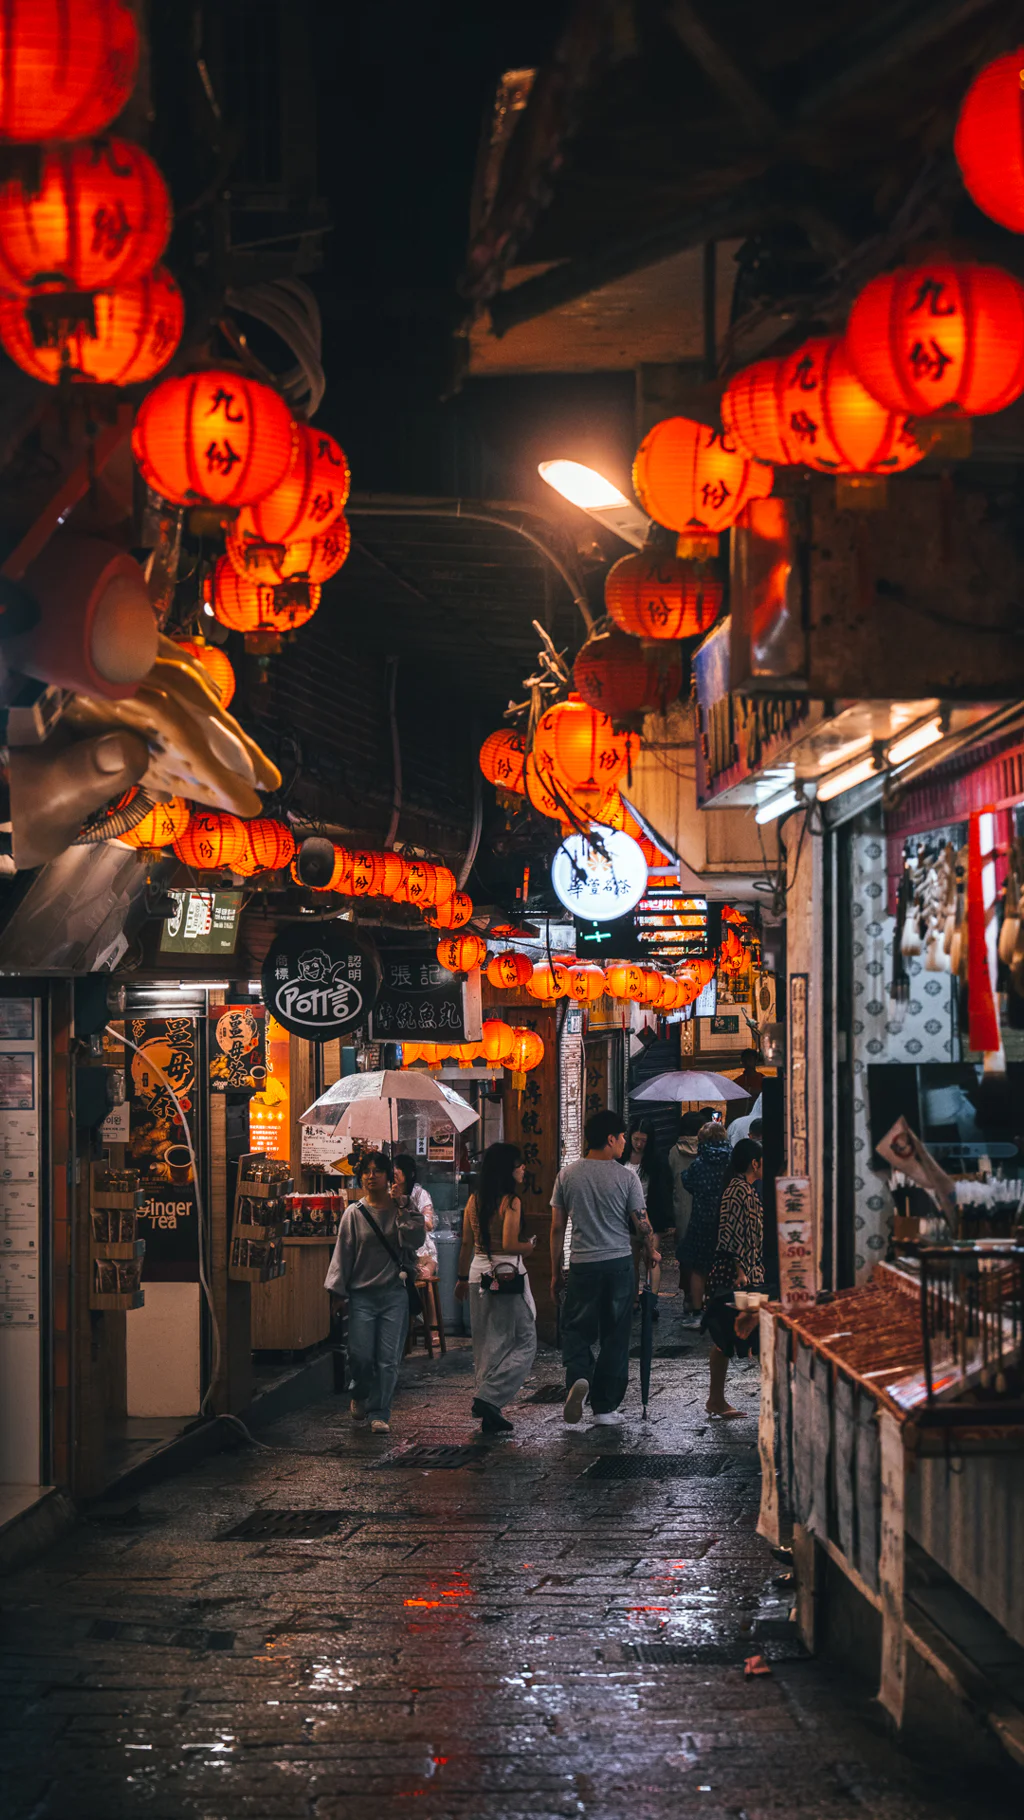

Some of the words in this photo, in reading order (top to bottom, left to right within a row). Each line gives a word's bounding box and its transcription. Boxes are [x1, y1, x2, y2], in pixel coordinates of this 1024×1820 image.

[909, 279, 956, 381] 九份
[789, 354, 817, 445] 九份
[205, 388, 243, 476] 九份
[308, 438, 342, 523] 九份
[702, 428, 736, 510] 九份
[644, 559, 673, 626] 九份
[198, 817, 214, 859] 九份
[355, 854, 372, 890] 九份
[410, 865, 423, 897] 九份
[454, 894, 467, 924] 九份
[274, 954, 290, 981] 商標
[348, 955, 362, 982] 認明
[390, 965, 441, 986] 張記
[503, 959, 517, 982] 九份
[575, 971, 585, 995] 九份
[629, 970, 638, 993] 九份
[377, 1001, 462, 1030] 傳統魚丸
[228, 1013, 248, 1087] 薑母茶
[147, 1018, 194, 1119] 薑母茶
[136, 1198, 193, 1218] Ginger
[148, 1215, 177, 1229] Tea
[787, 1261, 808, 1289] 三支
